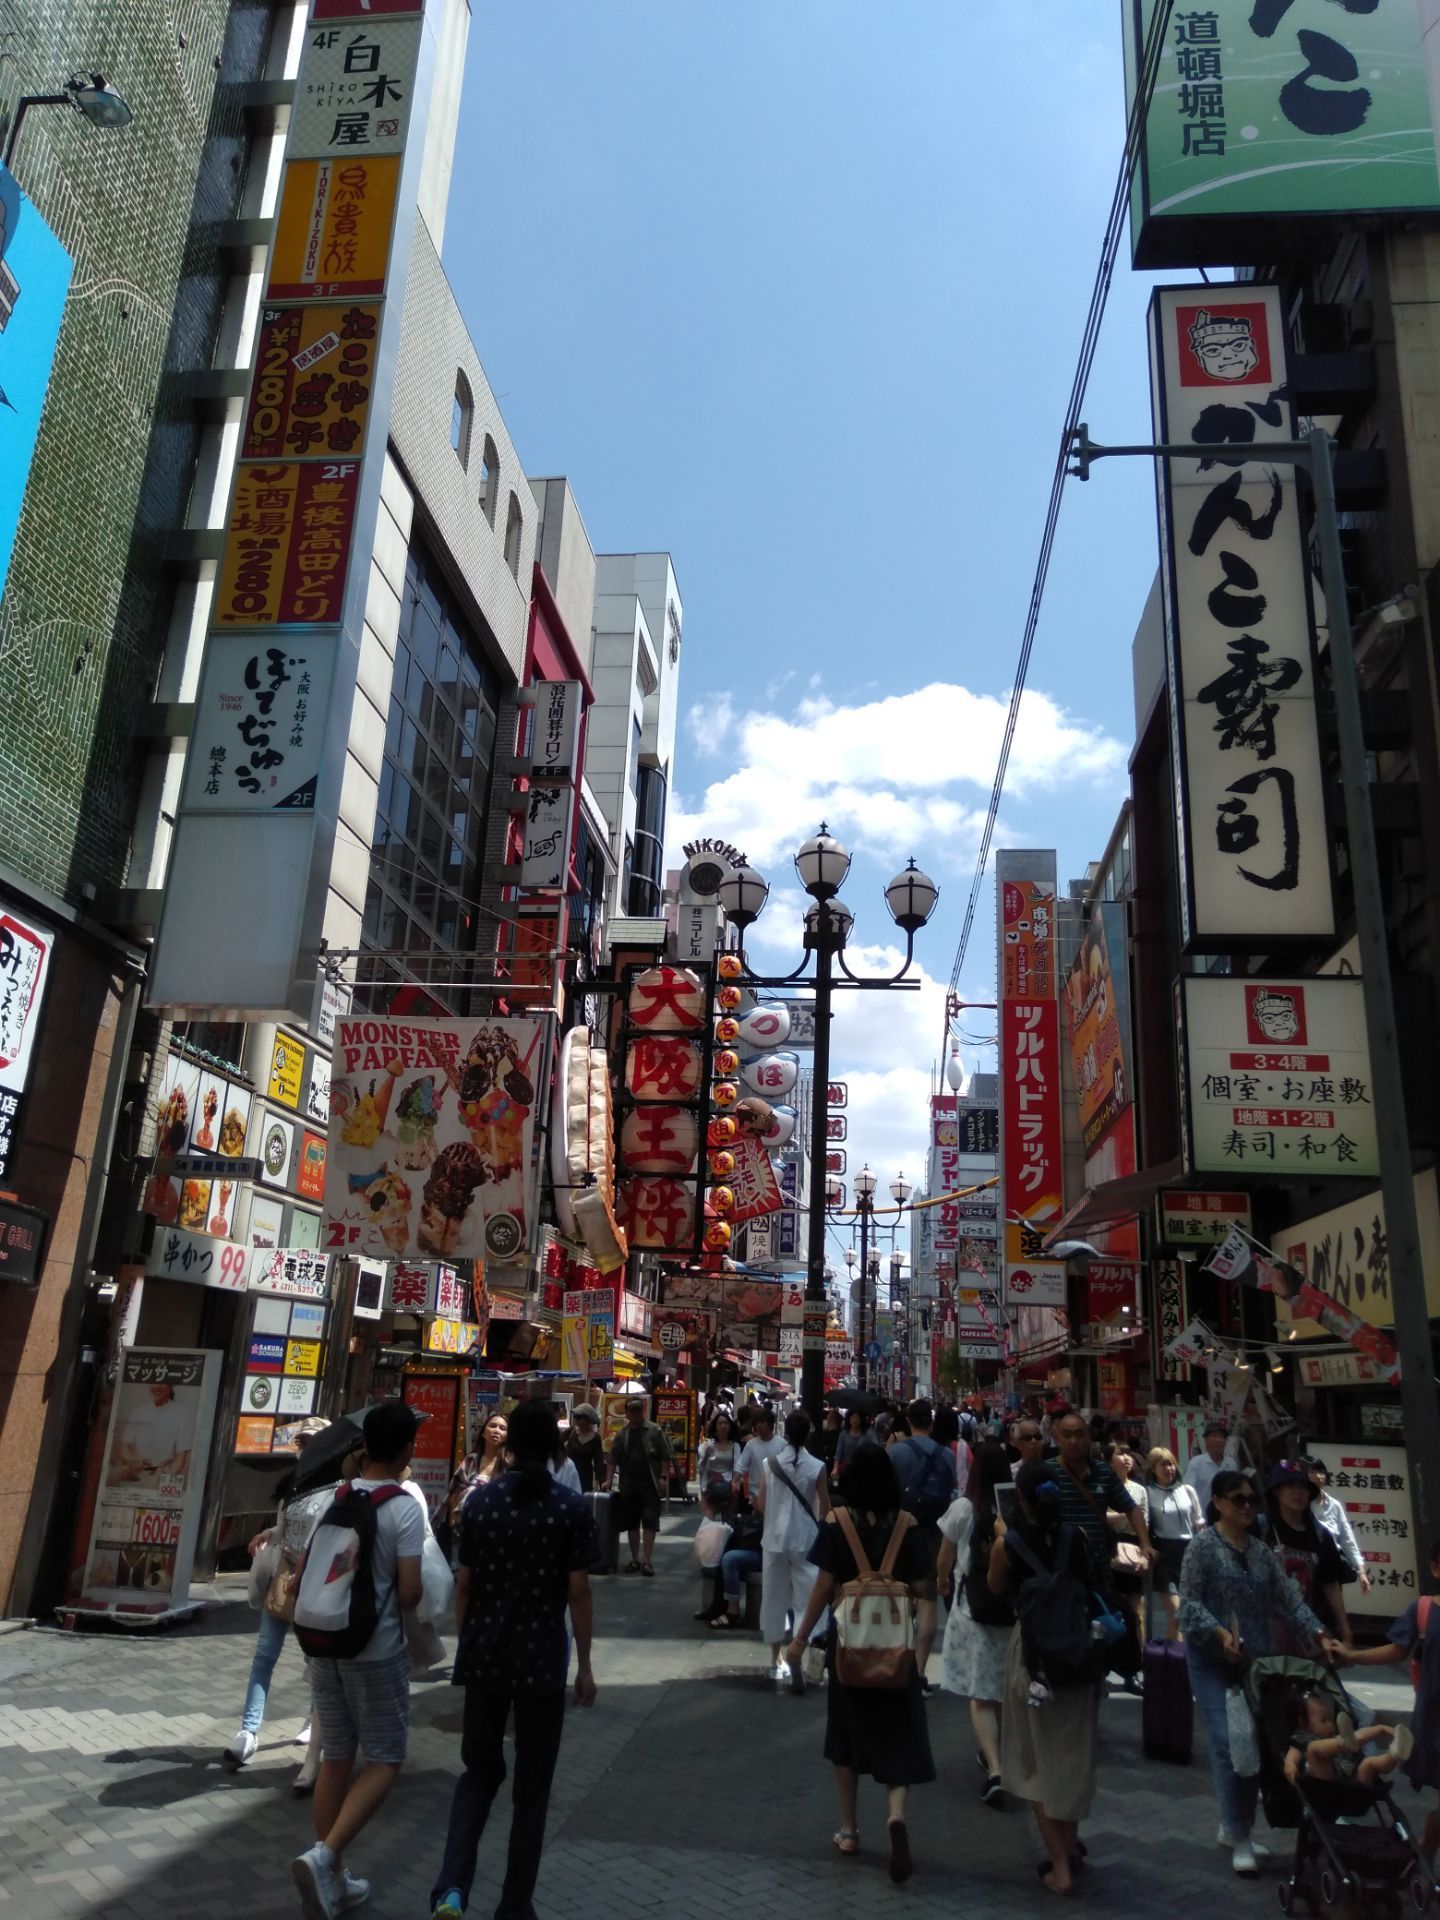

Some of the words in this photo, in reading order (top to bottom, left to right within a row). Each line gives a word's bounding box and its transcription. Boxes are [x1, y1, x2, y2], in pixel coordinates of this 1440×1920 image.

[312, 31, 341, 49] 4F
[328, 35, 403, 146] 白木屋
[1174, 11, 1226, 157] 道頓堀店
[306, 166, 330, 270] TORIKIZOKU
[264, 311, 282, 321] 3F
[294, 335, 340, 370] 居酒屋
[327, 307, 376, 452] たこやき
[321, 464, 355, 479] 2F
[231, 487, 296, 536] 酒場
[293, 482, 350, 621] 豊後高田どり
[231, 550, 274, 615] 280
[297, 671, 312, 695] 大阪
[219, 693, 244, 702] Since
[289, 698, 307, 748] お好み焼
[292, 792, 313, 805] 2F
[340, 1022, 461, 1049] MONSTER
[617, 966, 706, 1248] 大阪王将
[1015, 1006, 1048, 1192] ツルハドラッグ
[327, 1221, 361, 1247] 2F
[164, 1234, 214, 1274] 串かつ
[285, 1258, 326, 1284] 電球屋
[1089, 1266, 1134, 1281] ツルハ
[391, 1264, 430, 1309] 薬
[1091, 1283, 1124, 1293] ドラッグ
[259, 1344, 284, 1352] SAKURA
[780, 1343, 800, 1353] ZZA
[781, 1331, 800, 1340] STA
[589, 1346, 613, 1361] OFF
[128, 1365, 198, 1383] マッサージ
[288, 1384, 308, 1396] ZERO
[134, 1515, 180, 1544] 1600円
